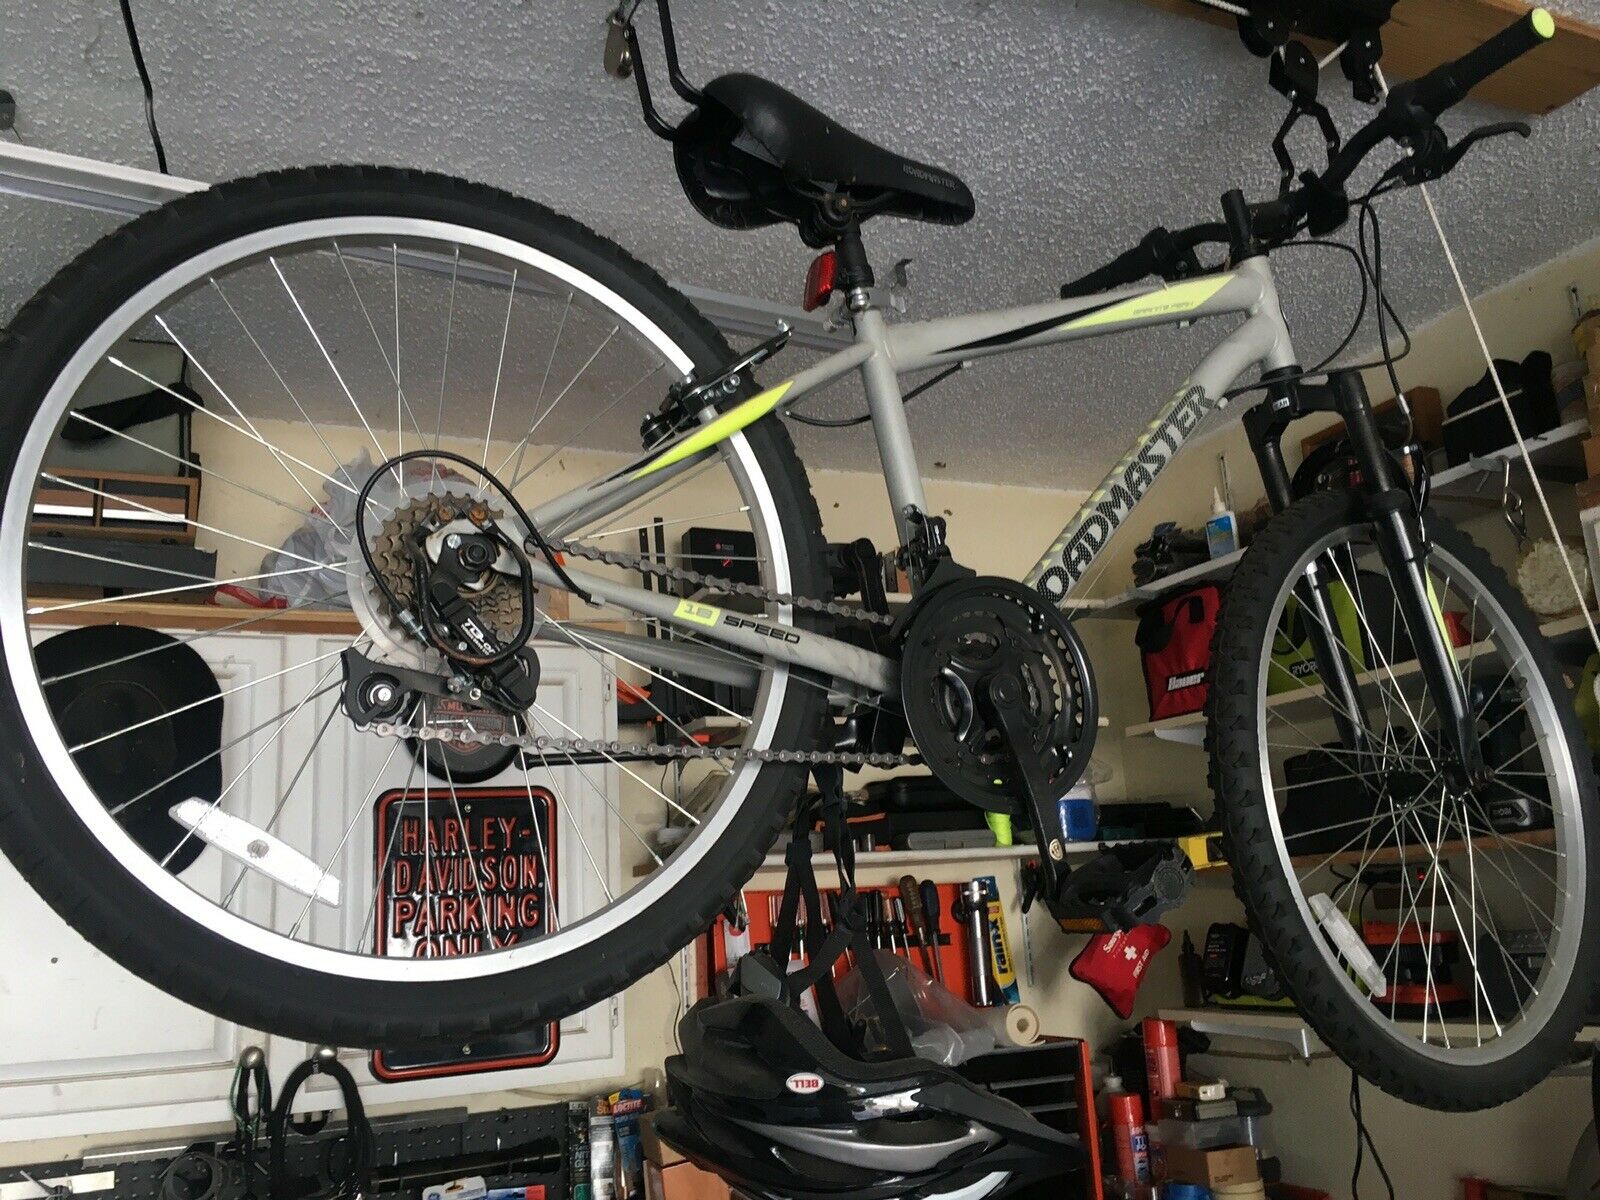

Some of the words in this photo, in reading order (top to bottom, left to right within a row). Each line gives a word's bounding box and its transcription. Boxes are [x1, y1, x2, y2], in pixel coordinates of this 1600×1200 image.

[1037, 385, 1216, 603] OADMASTER
[723, 614, 801, 644] SPEED
[1291, 659, 1319, 677] RYOB
[402, 816, 533, 854] HARLEY-
[394, 854, 540, 895] DAVIDSON
[393, 894, 541, 937] PARKING
[793, 1079, 819, 1089] BELL
